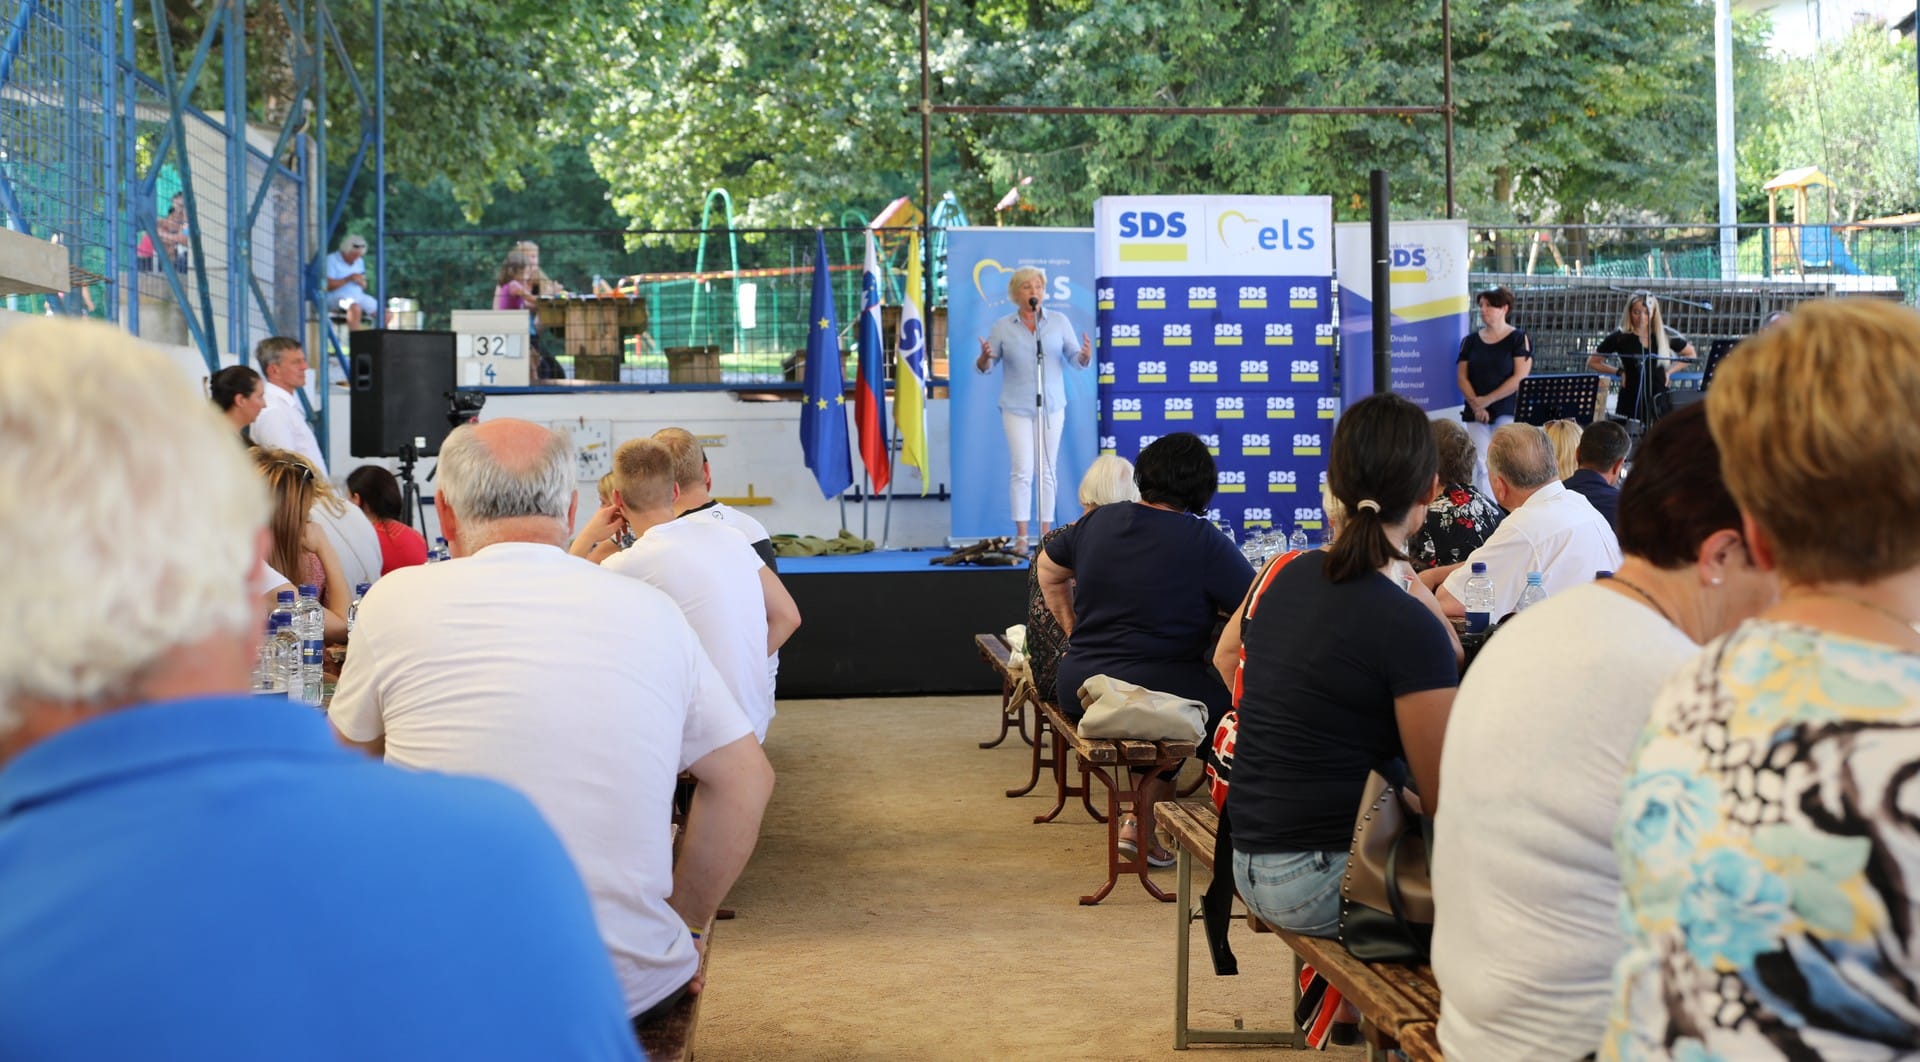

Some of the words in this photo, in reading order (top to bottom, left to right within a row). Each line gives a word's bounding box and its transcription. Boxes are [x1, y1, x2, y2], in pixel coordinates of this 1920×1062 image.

[1119, 211, 1187, 238] SDS
[1258, 219, 1315, 250] els
[1389, 248, 1426, 267] DS
[1137, 286, 1166, 300] SDS
[1188, 286, 1217, 300] SDS
[1239, 286, 1268, 300] SDS
[1289, 286, 1318, 300] SDS
[1111, 324, 1141, 337] SDS
[1163, 323, 1192, 337] SDS
[1214, 323, 1243, 337] SDS
[1265, 323, 1293, 337] SDS
[1315, 324, 1332, 337] SD
[477, 336, 504, 356] 32
[485, 363, 496, 384] 4
[1138, 361, 1167, 374] SDS
[1189, 360, 1218, 374] SDS
[1240, 360, 1269, 374] SDS
[1291, 360, 1319, 373] SDS
[1112, 398, 1142, 411] SDS
[1164, 397, 1193, 411] SDS
[1216, 396, 1244, 410] SDS
[1266, 396, 1295, 410] SDS
[1317, 397, 1334, 410] SD
[1242, 434, 1271, 447] SDS
[1293, 433, 1321, 447] SDS
[1217, 471, 1246, 484] SDS
[1268, 470, 1297, 484] SDS
[1244, 507, 1272, 521] SDS
[1295, 507, 1323, 521] SDS
